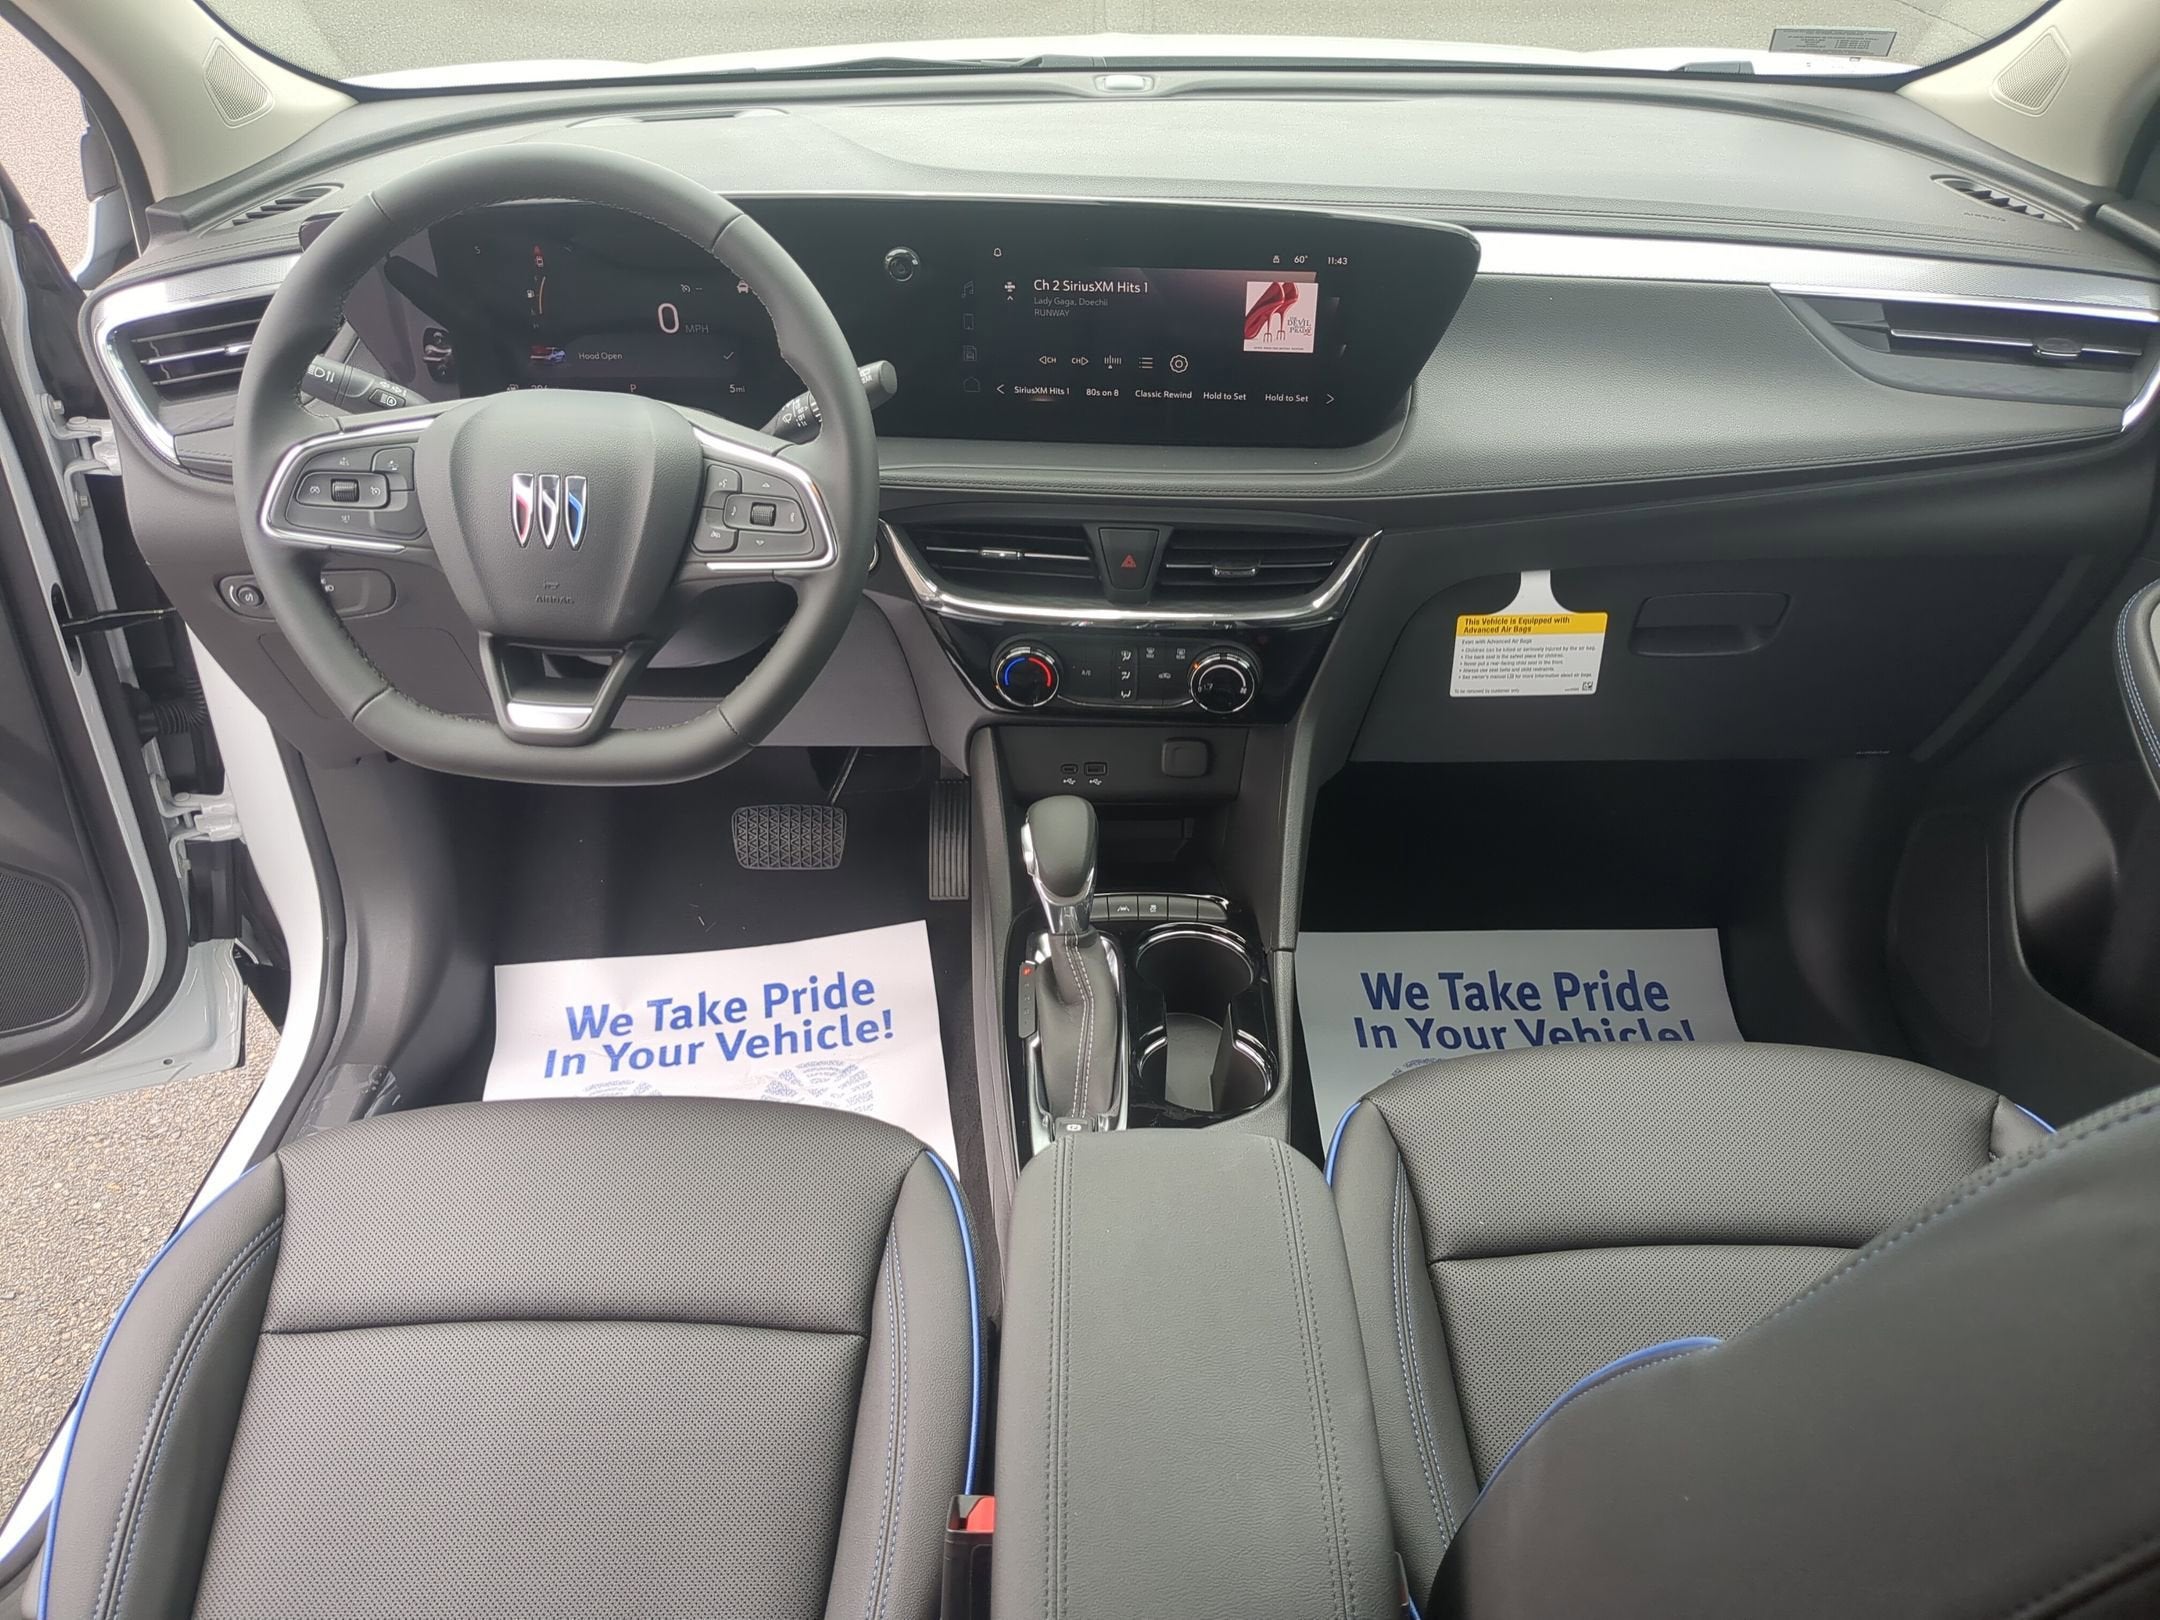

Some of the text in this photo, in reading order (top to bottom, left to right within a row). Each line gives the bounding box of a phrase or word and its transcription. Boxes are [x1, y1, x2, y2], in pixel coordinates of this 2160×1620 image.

[1294, 255, 1308, 263] 60°
[1328, 257, 1348, 265] 11:43
[1034, 279, 1049, 291] Ch
[1053, 280, 1060, 291] 2
[1063, 280, 1114, 292] SiriusXM
[1117, 281, 1140, 293] Hits
[1034, 297, 1052, 306] Lady
[1054, 297, 1077, 308] Gaga,
[1034, 308, 1069, 317] RUNWAY
[658, 303, 709, 334] 0 MPH
[1287, 318, 1312, 326] DEVIL
[579, 351, 622, 361] Hood Open
[630, 384, 637, 393] P
[1014, 386, 1047, 395] SiriusXM
[1050, 387, 1065, 395] Hits
[1086, 388, 1100, 396] 80s
[1114, 389, 1119, 397] 8
[1135, 390, 1192, 399] Classic Rewind
[1203, 392, 1247, 401] Hold to Set
[1265, 393, 1309, 403] Hold to Set
[1465, 616, 1570, 626] This Vehicle is Equipped with
[1464, 625, 1532, 634] Advanced Air Bags
[1360, 970, 1671, 1012] We Take Pride
[565, 971, 876, 1041] We Take Pride
[1354, 1017, 1397, 1048] In
[1405, 1018, 1507, 1050] Your
[543, 1009, 894, 1078] In Your Vehicle!
